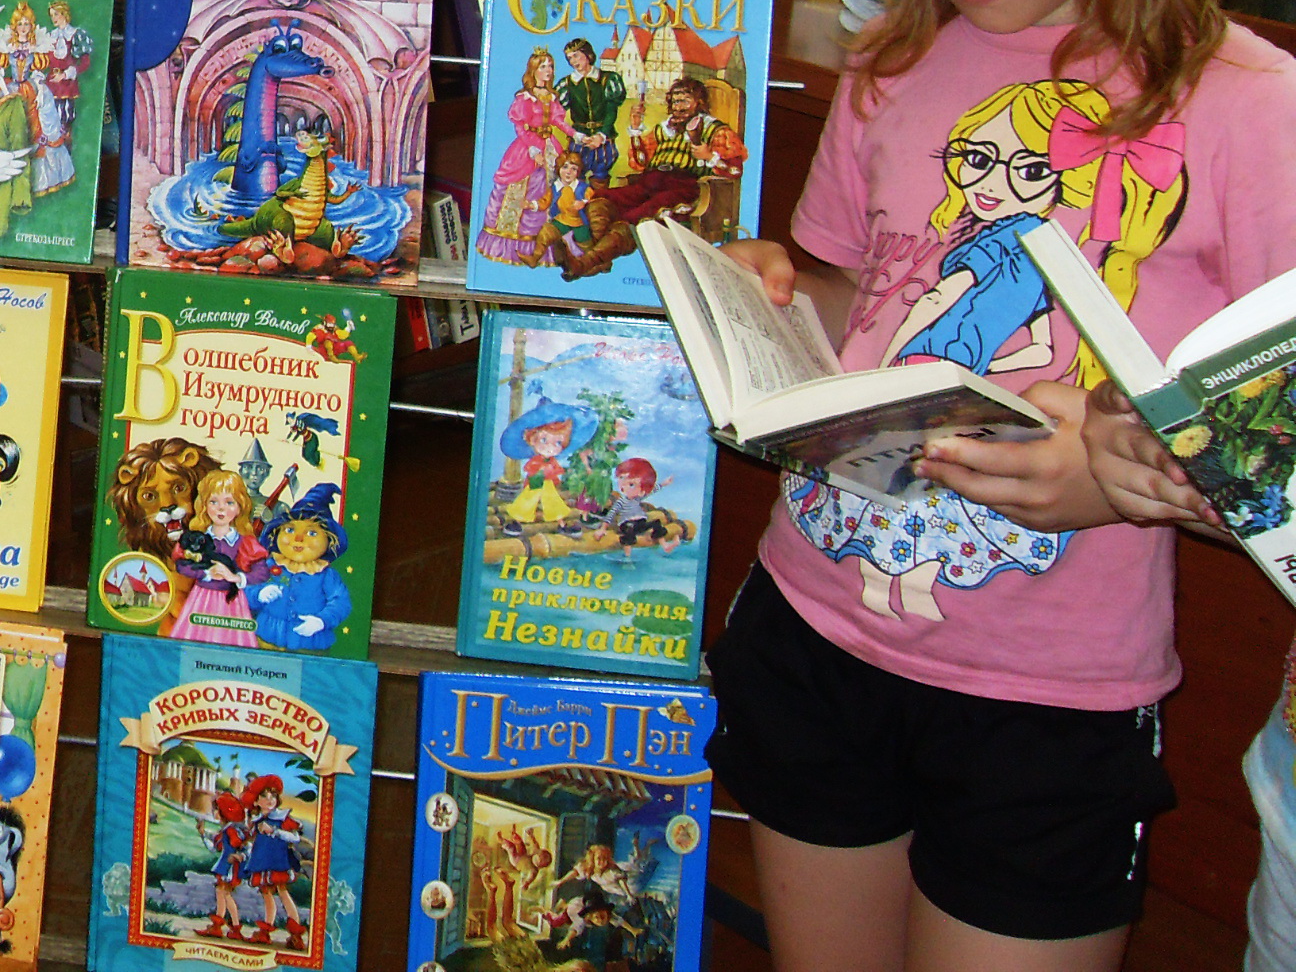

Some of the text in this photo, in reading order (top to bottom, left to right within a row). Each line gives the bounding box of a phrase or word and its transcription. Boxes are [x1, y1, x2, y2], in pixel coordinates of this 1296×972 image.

[15, 232, 76, 247] СТРЕКОЗА-ПРЕСС
[175, 307, 311, 335] Александр Волков
[181, 369, 342, 415] Изумрудного
[179, 407, 270, 439] города
[499, 554, 613, 590] Новые
[491, 587, 688, 621] приключения
[192, 614, 254, 630] СТРЕКОЗА-ПРЕСС
[483, 609, 688, 660] Незнайки
[195, 660, 288, 680] Виталий Губарев
[154, 686, 324, 734] КОРОЛЕВСТВО
[507, 699, 593, 717] Джеймс Барри
[156, 708, 320, 755] КРИВЫХ ЗЕРКАЛ
[447, 689, 693, 767] Питер Пэн
[185, 947, 264, 967] ЧИТАЕМ САМИ
